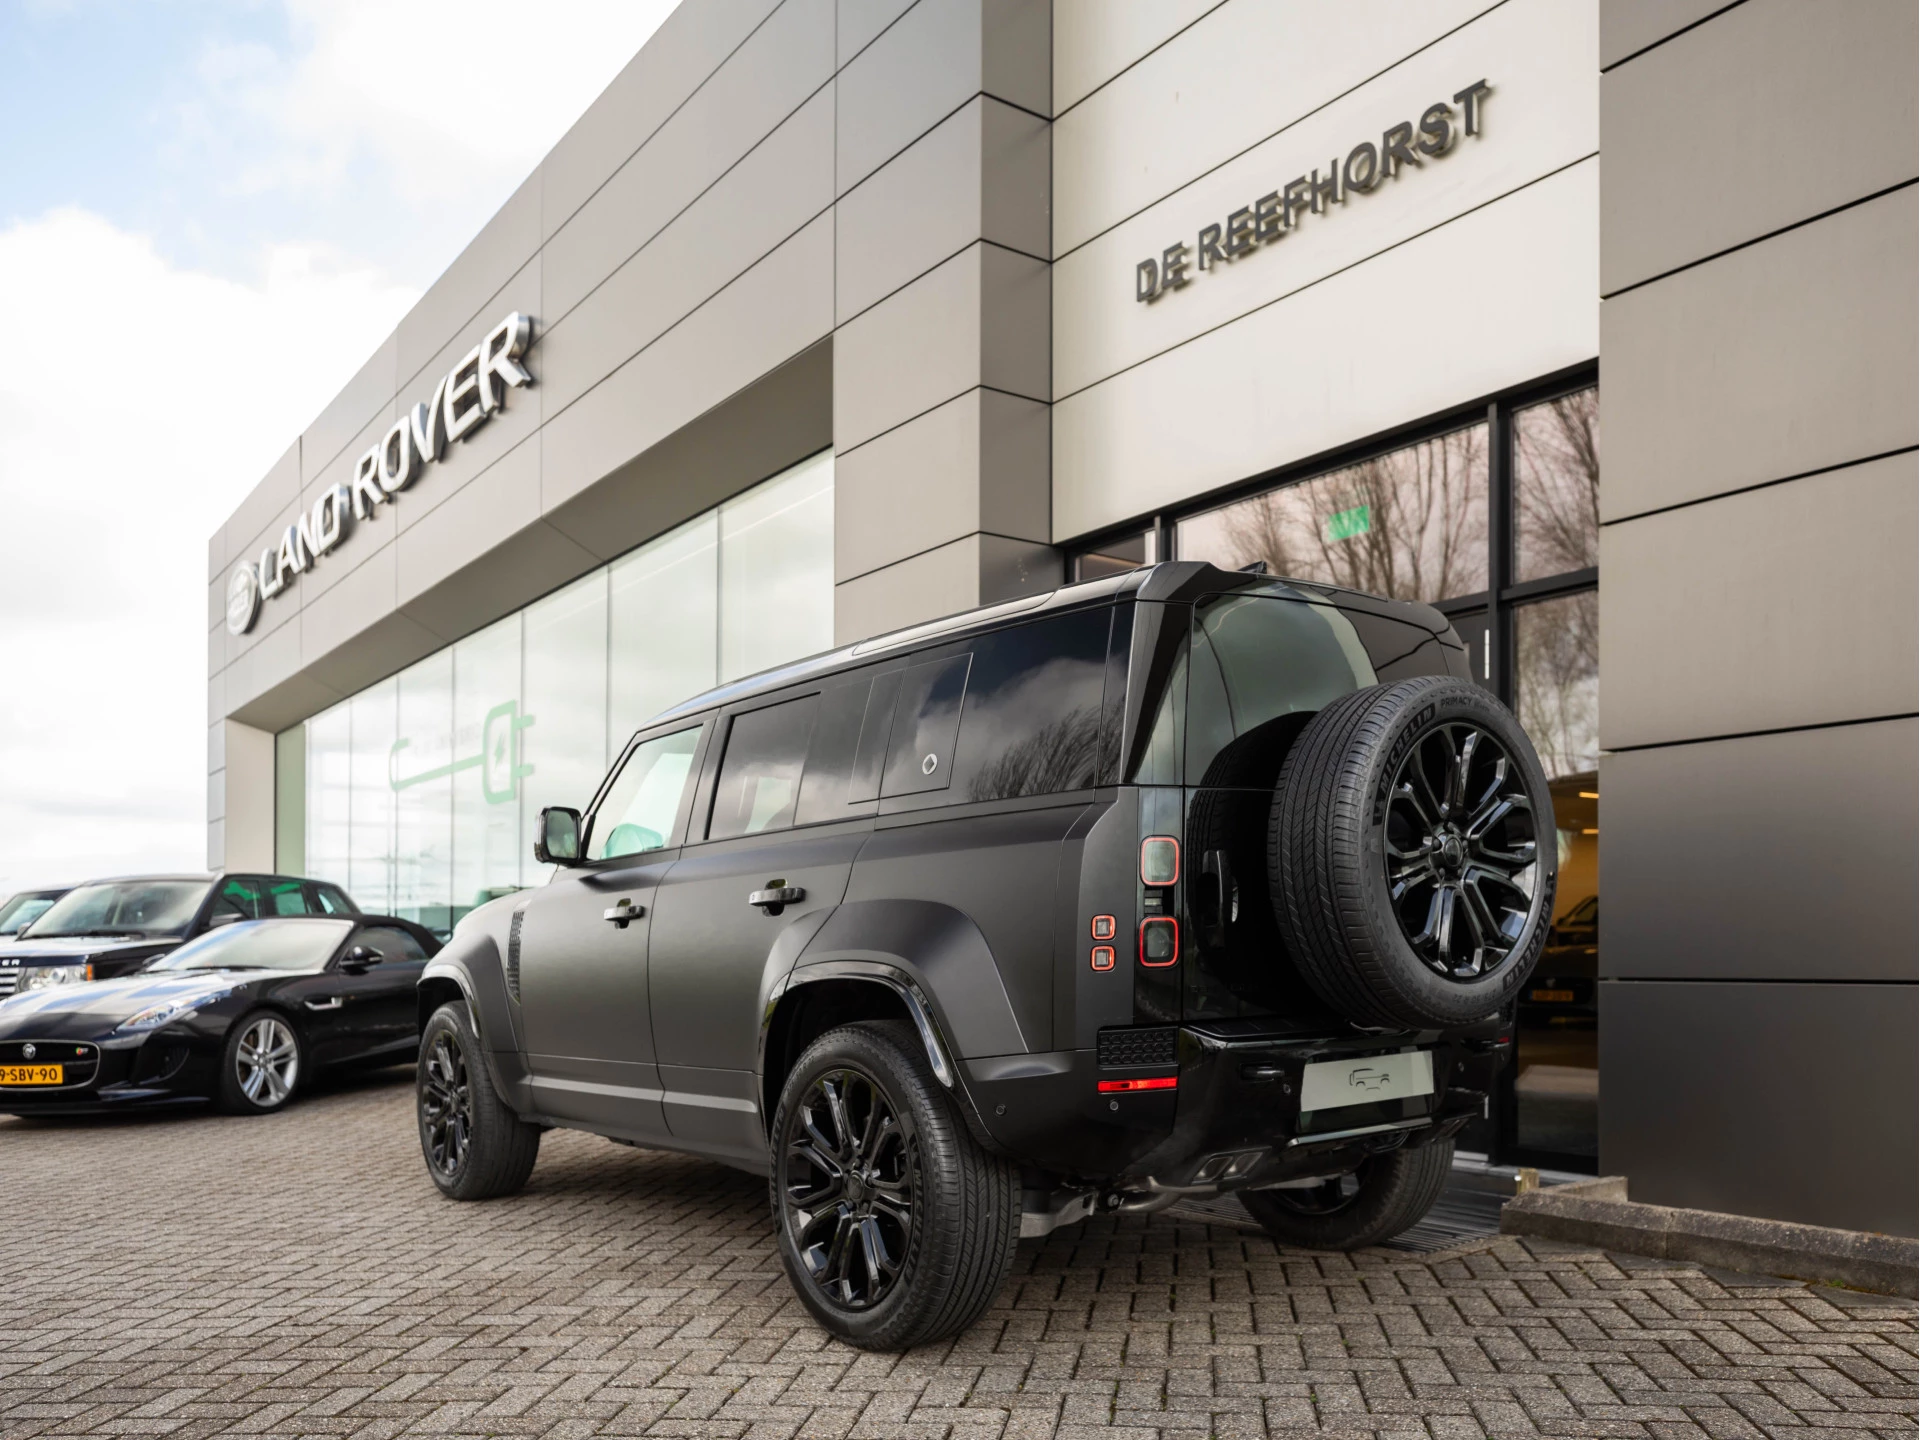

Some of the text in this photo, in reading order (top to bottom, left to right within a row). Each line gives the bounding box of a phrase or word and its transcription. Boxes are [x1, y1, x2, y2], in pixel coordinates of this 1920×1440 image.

[1136, 79, 1488, 302] DE REEFHORST
[259, 311, 531, 601] LAND ROVER
[1440, 696, 1473, 708] PRIMACY
[1379, 706, 1433, 795] MICHELIN
[1505, 900, 1550, 987] MICHELIN
[0, 1067, 58, 1082] 9-SBV-90
[905, 1168, 924, 1280] MICHELIN
